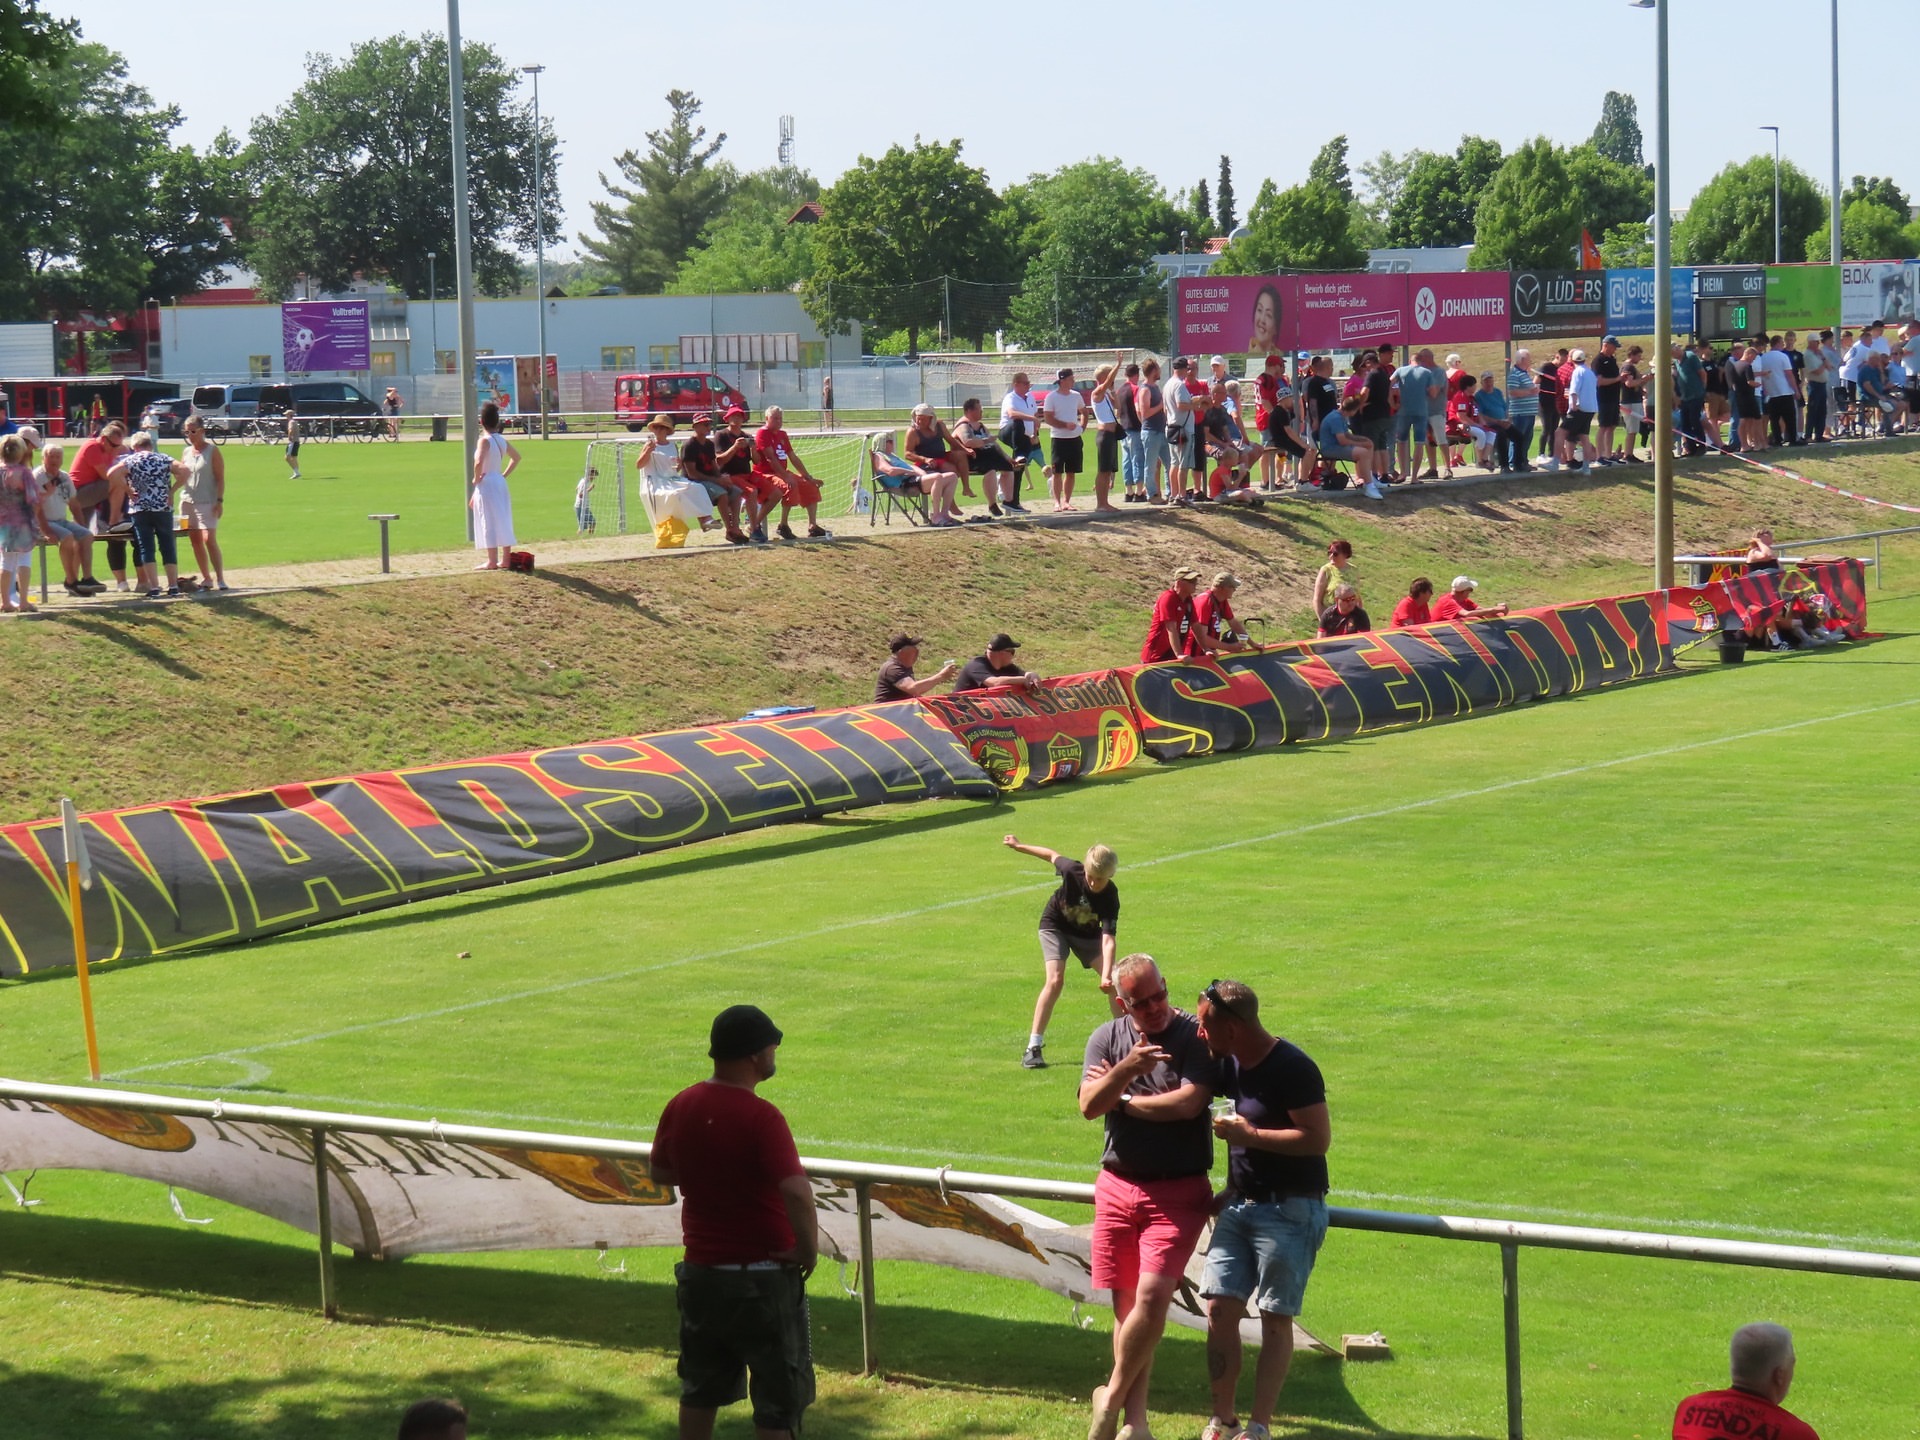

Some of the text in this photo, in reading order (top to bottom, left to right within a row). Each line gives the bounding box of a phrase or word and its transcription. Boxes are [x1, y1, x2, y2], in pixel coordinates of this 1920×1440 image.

[1304, 283, 1352, 296] Bewirb dich jetzt:
[1546, 275, 1602, 303] LÜDERS
[1702, 277, 1723, 292] HEIM
[1742, 276, 1763, 291] GAST
[1185, 286, 1230, 299] GUTES GELD FÜR
[332, 307, 365, 316] Volltreffer!
[1185, 302, 1229, 314] GUTE LEISTUNG?
[1440, 297, 1505, 317] JOHANNITER
[1186, 323, 1221, 334] GUTE SACHE.
[1343, 316, 1398, 333] Auch in Gardelegen!
[1030, 674, 1127, 716] Stendal
